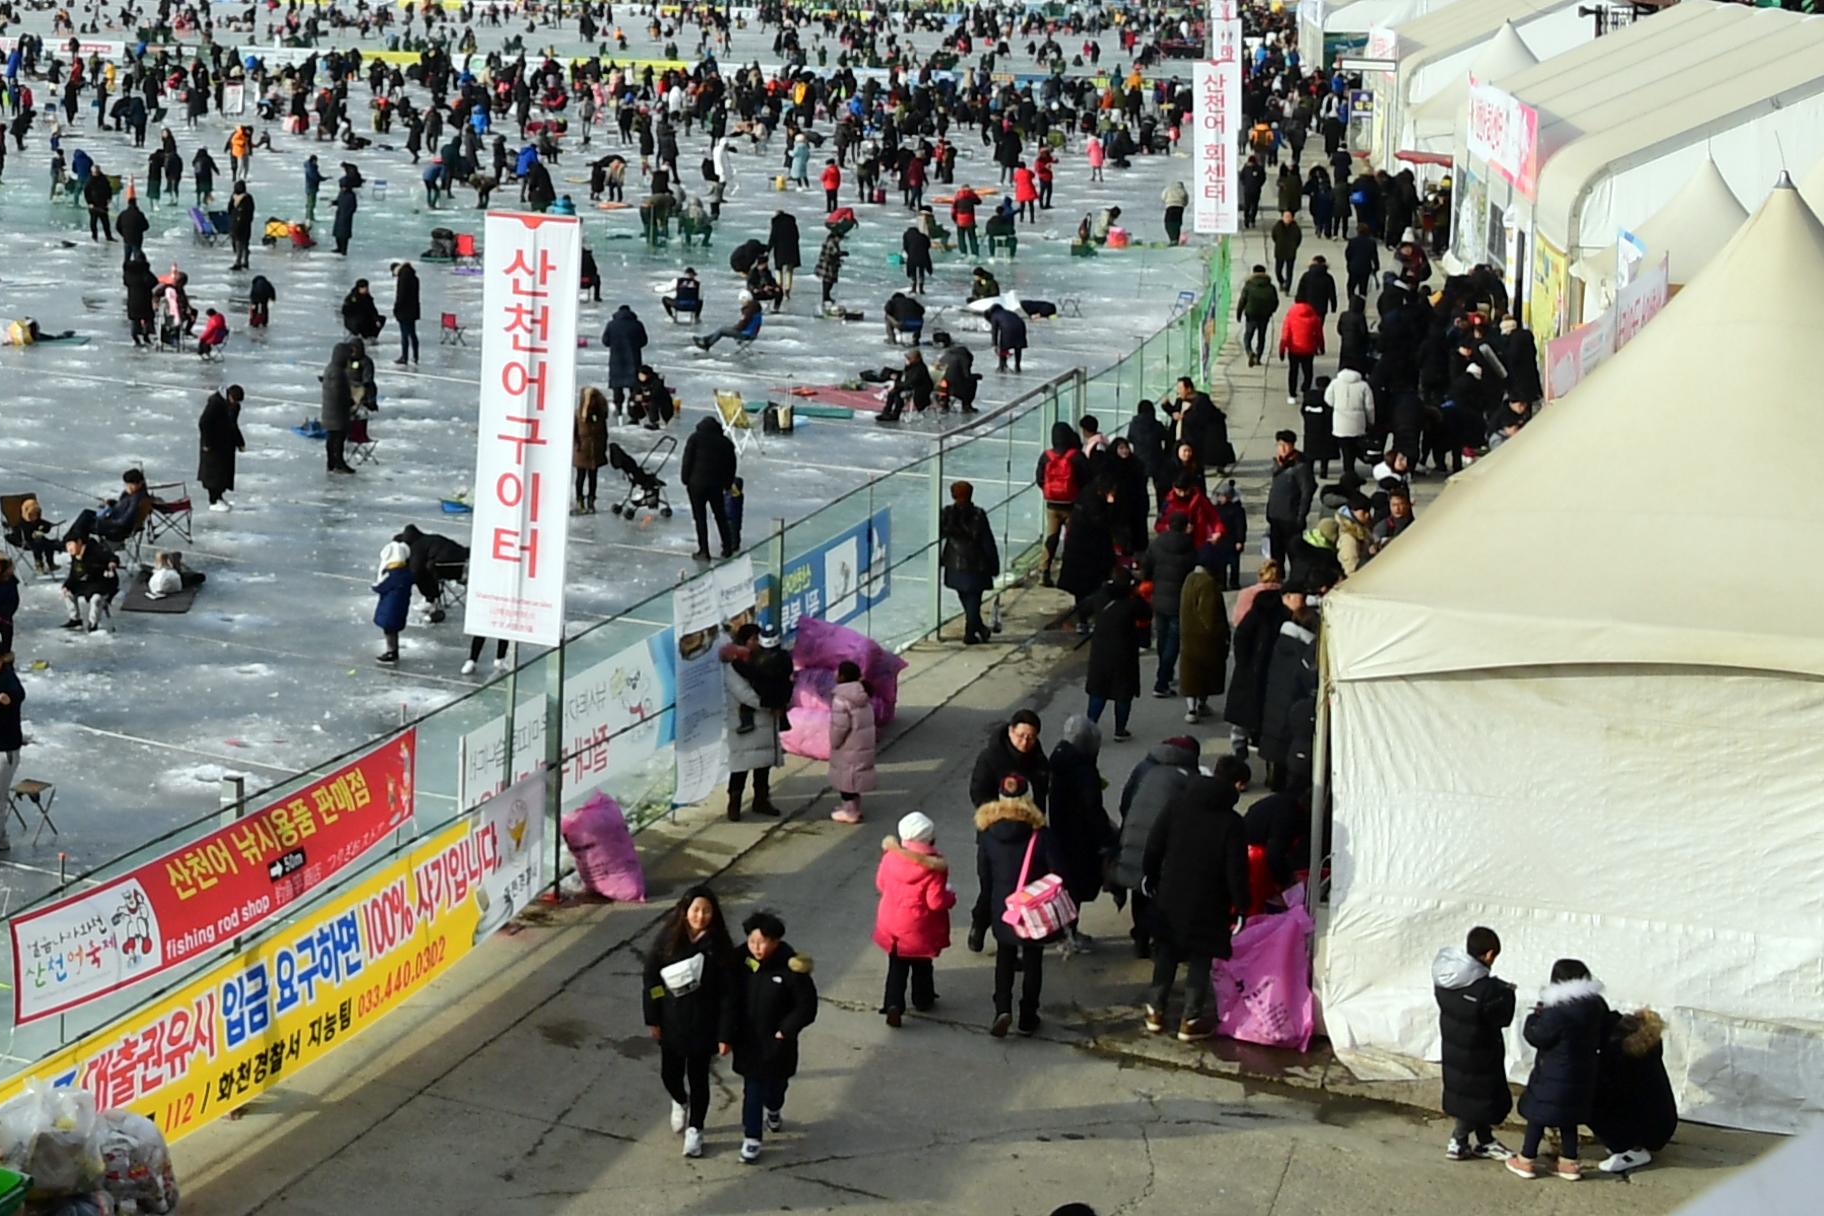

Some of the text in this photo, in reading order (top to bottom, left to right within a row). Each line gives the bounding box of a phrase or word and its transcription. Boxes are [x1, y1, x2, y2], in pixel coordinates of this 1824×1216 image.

[1203, 73, 1227, 136] 산천어
[1203, 143, 1227, 205] 회센터
[491, 248, 557, 579] 산천어구이터
[165, 767, 371, 901] 산천어 낚시용품 판매점
[283, 852, 304, 872] 50m
[80, 820, 504, 1113] 대출권유시 입금 요구하면 100% 사기입니다.
[166, 894, 271, 959] fishing rod shop
[166, 1092, 196, 1131] 112
[216, 1034, 302, 1104] 화천경찰서
[307, 998, 353, 1049] 지능팀
[357, 941, 447, 1017] 033.440.0302
